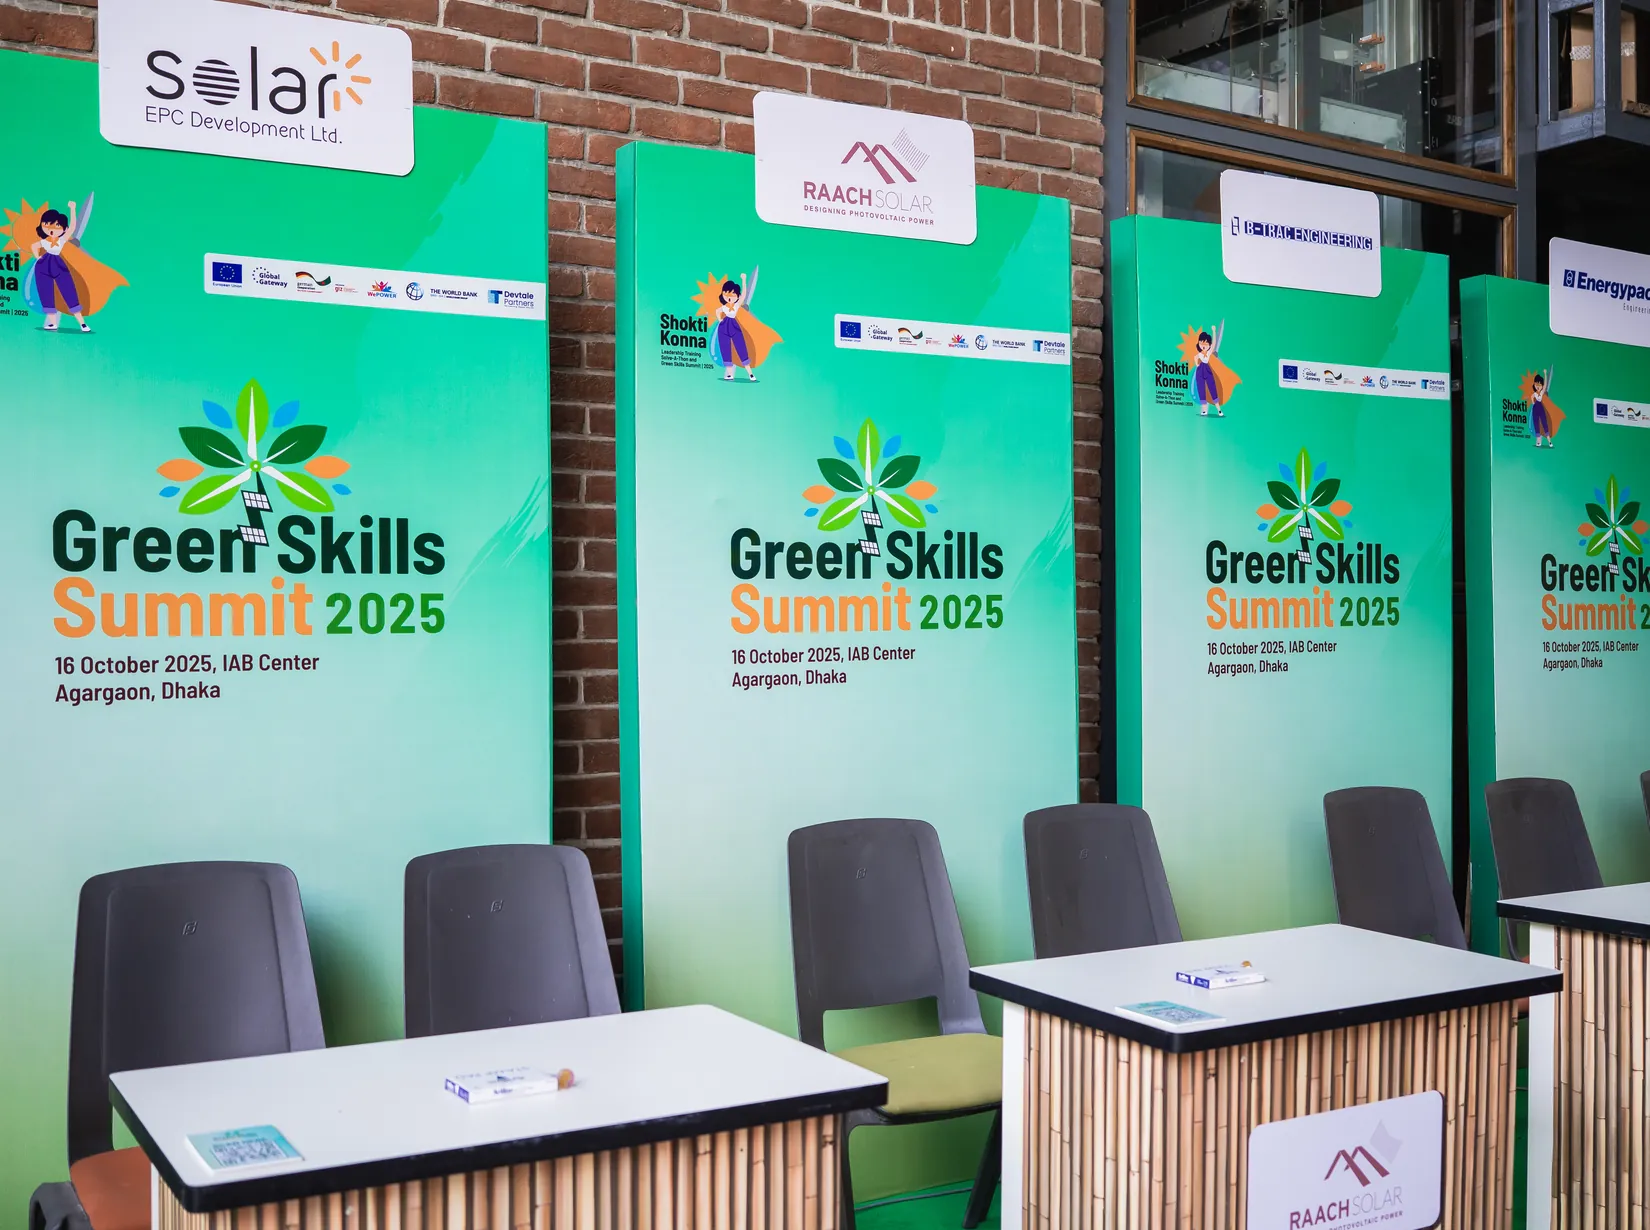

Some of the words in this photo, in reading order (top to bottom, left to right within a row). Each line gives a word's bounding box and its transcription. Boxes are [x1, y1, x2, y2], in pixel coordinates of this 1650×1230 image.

[145, 105, 184, 126] EPC
[191, 111, 305, 140] Development
[311, 125, 343, 144] Ltd.
[803, 180, 872, 207] RAACH
[875, 189, 934, 214] SOLAR
[804, 204, 846, 216] DESIGNING
[850, 210, 906, 223] PHOTOVOLTAIC
[908, 216, 934, 226] POWER
[1245, 220, 1292, 240] B-TRAC
[1294, 227, 1373, 250] ENGINEERING
[259, 272, 280, 280] Global
[259, 278, 288, 288] Gateway
[504, 290, 534, 300] Devtale
[504, 298, 534, 307] Partners
[660, 314, 708, 332] Shokti
[660, 330, 707, 348] Konna
[1155, 360, 1189, 376] Shokti
[1155, 374, 1188, 389] Konna
[1502, 398, 1528, 412] Shokti
[1502, 410, 1527, 424] Konna
[52, 509, 257, 574] Green
[277, 514, 446, 575] Skills
[730, 528, 872, 580] Green
[886, 530, 1004, 580] Skills
[1206, 540, 1306, 584] Green
[1316, 542, 1400, 584] Skills
[1541, 553, 1615, 592] Green
[53, 576, 314, 639] Summit
[326, 592, 446, 635] 2025
[731, 582, 912, 635] Summit
[920, 594, 1004, 630] 2025
[1206, 585, 1334, 630] Summit
[1340, 596, 1400, 627] 2025
[1542, 593, 1637, 631] Summit
[732, 649, 746, 665] 16
[750, 648, 804, 664] October
[808, 647, 844, 664] 2025,
[848, 646, 870, 662] IAB
[873, 646, 916, 660] Center
[1207, 642, 1218, 655] 16
[1220, 642, 1258, 655] October
[1260, 641, 1287, 655] 2025,
[1289, 640, 1305, 654] IAB
[1306, 640, 1338, 652] Center
[1542, 641, 1550, 653] 16
[1552, 641, 1580, 652] October
[1582, 640, 1602, 653] 2025,
[1602, 640, 1614, 652] IAB
[1616, 640, 1639, 652] Center
[55, 656, 75, 675] 16
[80, 656, 160, 675] October
[164, 654, 218, 676] 2025,
[223, 654, 254, 672] IAB
[258, 654, 320, 672] Center
[1208, 662, 1257, 678] Agargaon,
[1259, 660, 1289, 672] Dhaka
[1543, 658, 1580, 672] Agargaon,
[1581, 657, 1603, 668] Dhaka
[732, 672, 802, 691] Agargaon,
[806, 669, 847, 685] Dhaka
[55, 683, 156, 706] Agargaon,
[162, 680, 221, 700] Dhaka
[1290, 1198, 1350, 1230] RAACH
[1352, 1186, 1403, 1216] SOLAR
[1380, 1210, 1404, 1221] POWER
